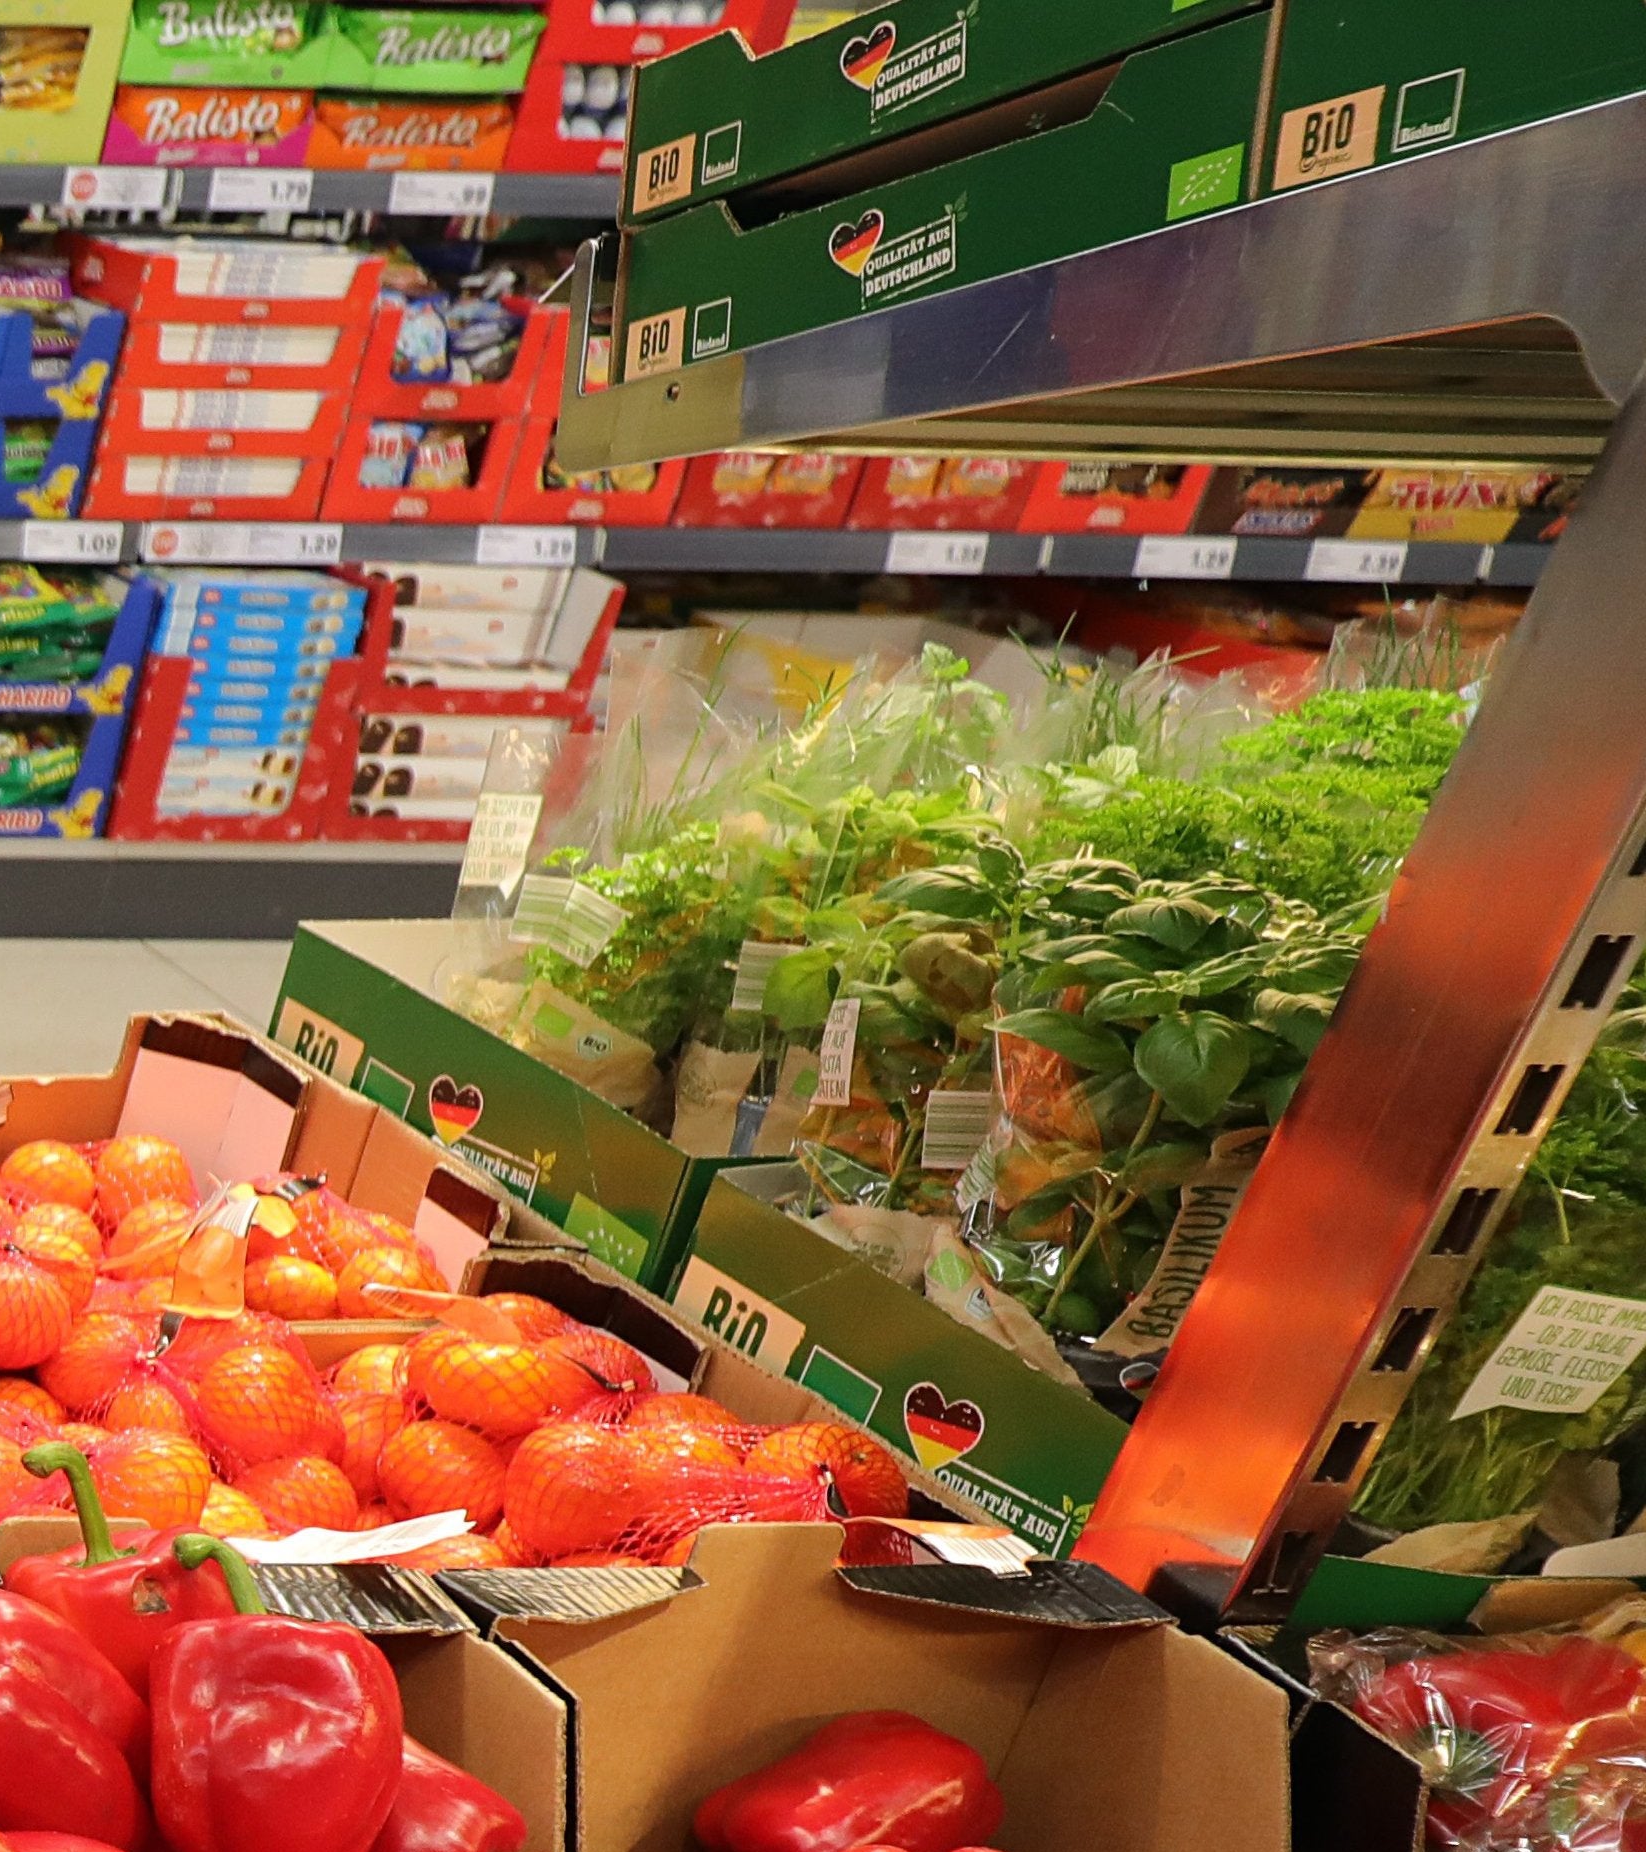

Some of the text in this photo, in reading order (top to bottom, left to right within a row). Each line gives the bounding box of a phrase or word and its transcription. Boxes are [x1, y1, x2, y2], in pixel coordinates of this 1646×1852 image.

[159, 2, 295, 46] Balisto
[376, 26, 511, 66] Balisto
[874, 55, 961, 110] DEUTSCHLAND
[876, 33, 961, 88] QUALITÄT AUS
[143, 97, 281, 144] Balisto
[342, 114, 478, 148] Balisto
[865, 226, 951, 275] QUALITÄT AUS
[865, 247, 951, 298] DEUTSCHLAND
[508, 1164, 533, 1191] AUS
[1126, 1185, 1239, 1338] BASILIKUM
[1535, 1295, 1563, 1318] ICH
[1565, 1300, 1615, 1326] PASSE
[1500, 1375, 1537, 1400] UND
[935, 1466, 1060, 1544] QUALITÄT AUS
